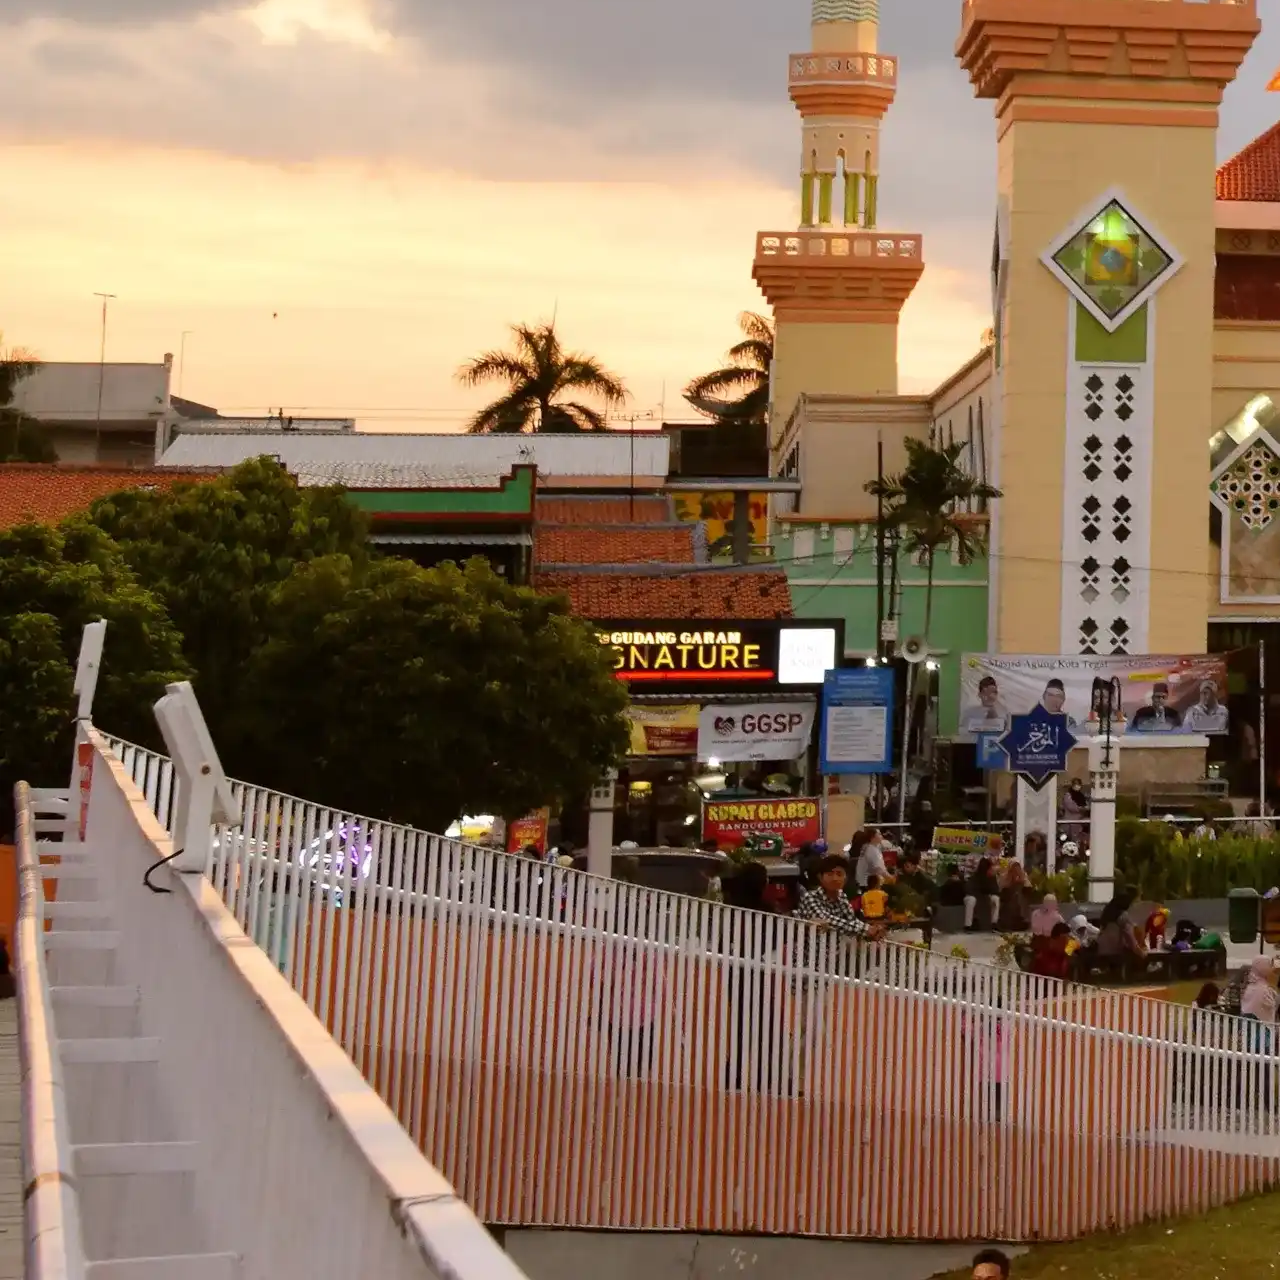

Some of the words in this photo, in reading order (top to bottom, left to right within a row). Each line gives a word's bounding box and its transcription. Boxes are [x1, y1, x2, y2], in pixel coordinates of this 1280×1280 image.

[611, 631, 677, 645] GUDANG
[680, 631, 741, 645] GARAM
[741, 714, 803, 734] GGSP
[708, 804, 757, 821] KUPAT
